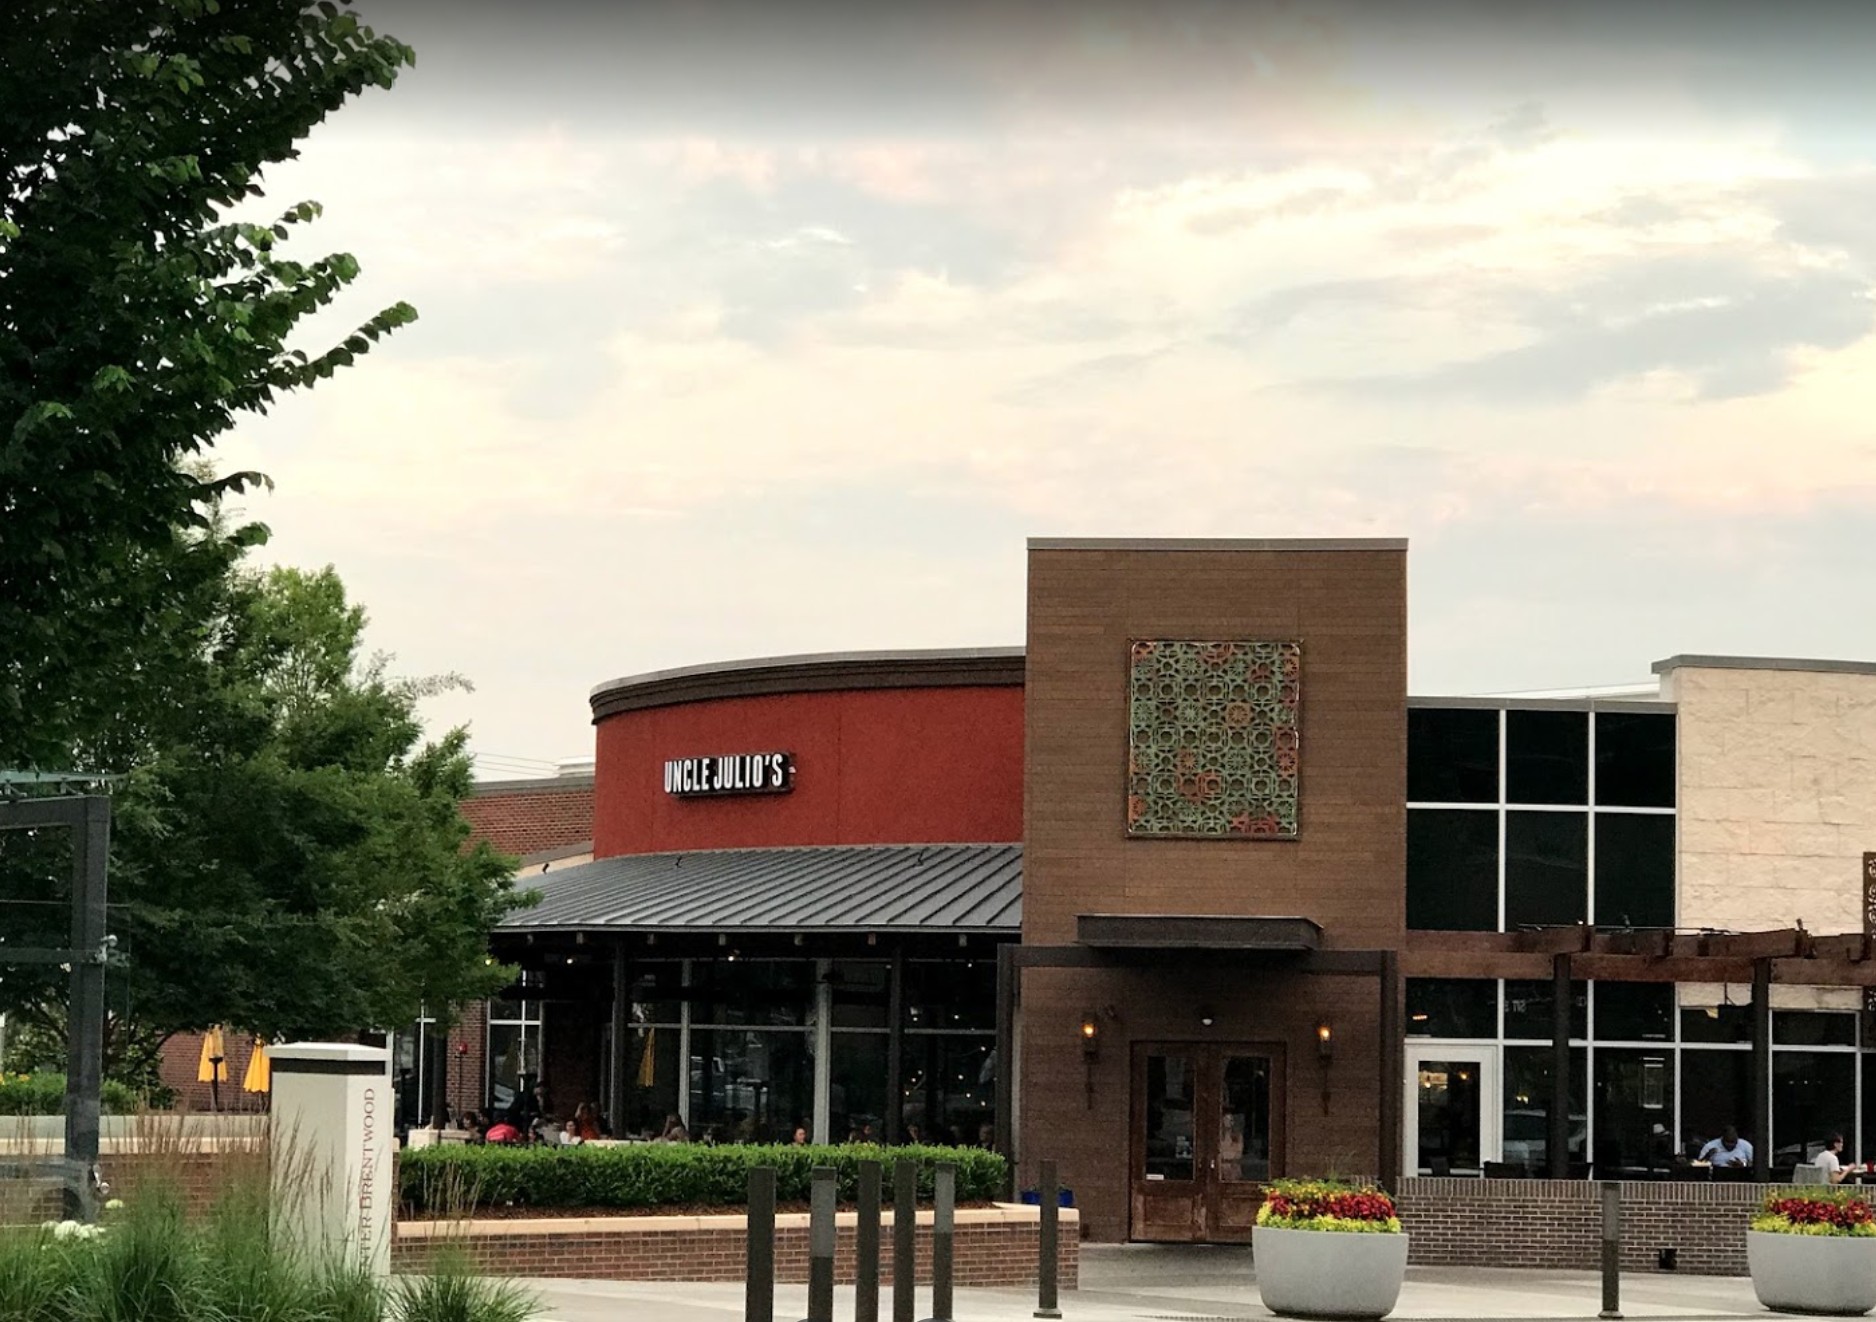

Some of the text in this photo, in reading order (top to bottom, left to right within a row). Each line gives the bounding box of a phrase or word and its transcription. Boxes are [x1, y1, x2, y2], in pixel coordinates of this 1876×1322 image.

[664, 753, 783, 793] UNCLE JULIO'S
[360, 1088, 375, 1209] BRENTWOOD
